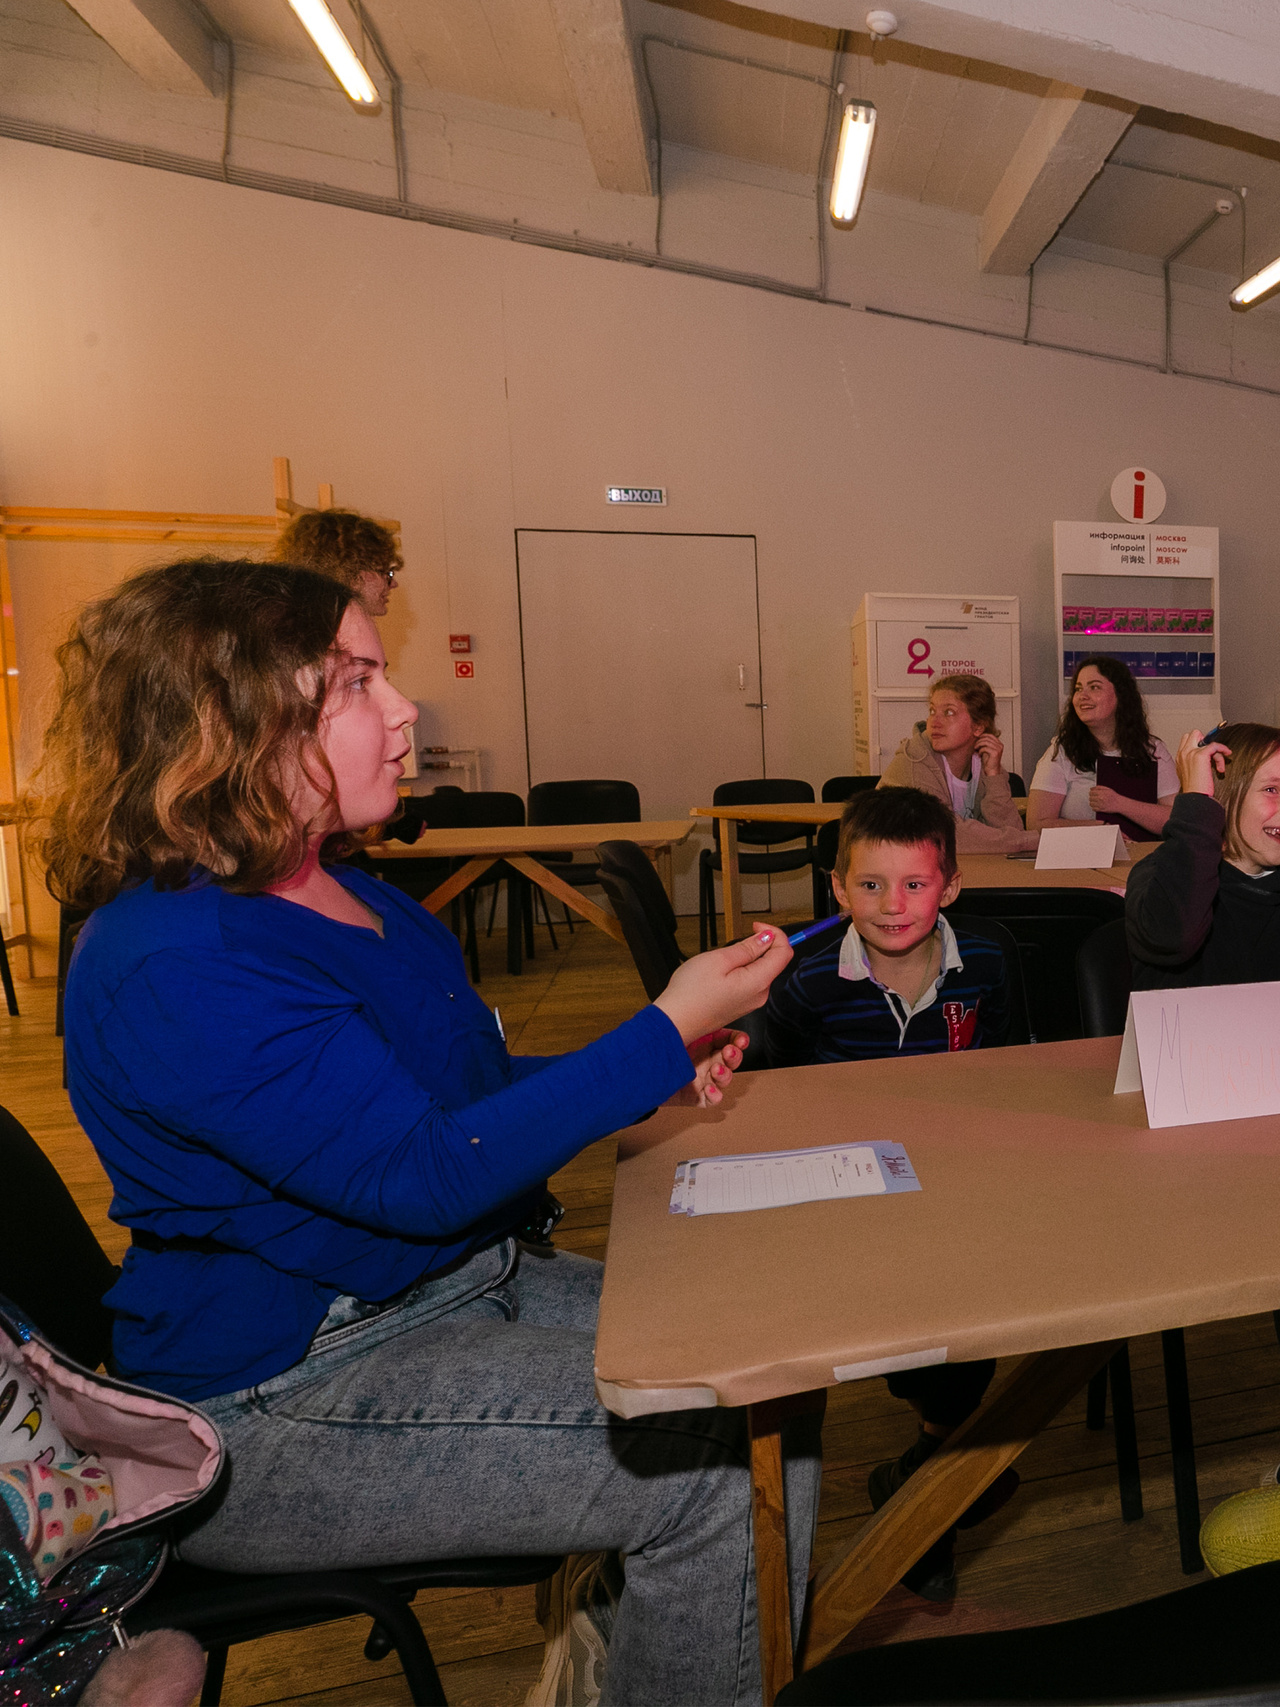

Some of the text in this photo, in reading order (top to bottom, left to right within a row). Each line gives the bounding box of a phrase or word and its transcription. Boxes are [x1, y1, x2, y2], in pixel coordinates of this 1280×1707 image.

[611, 488, 661, 502] ВЫХОД
[1089, 531, 1145, 541] информация
[1110, 543, 1145, 552] infopoint
[941, 668, 985, 676] ДЫХАНИЕ
